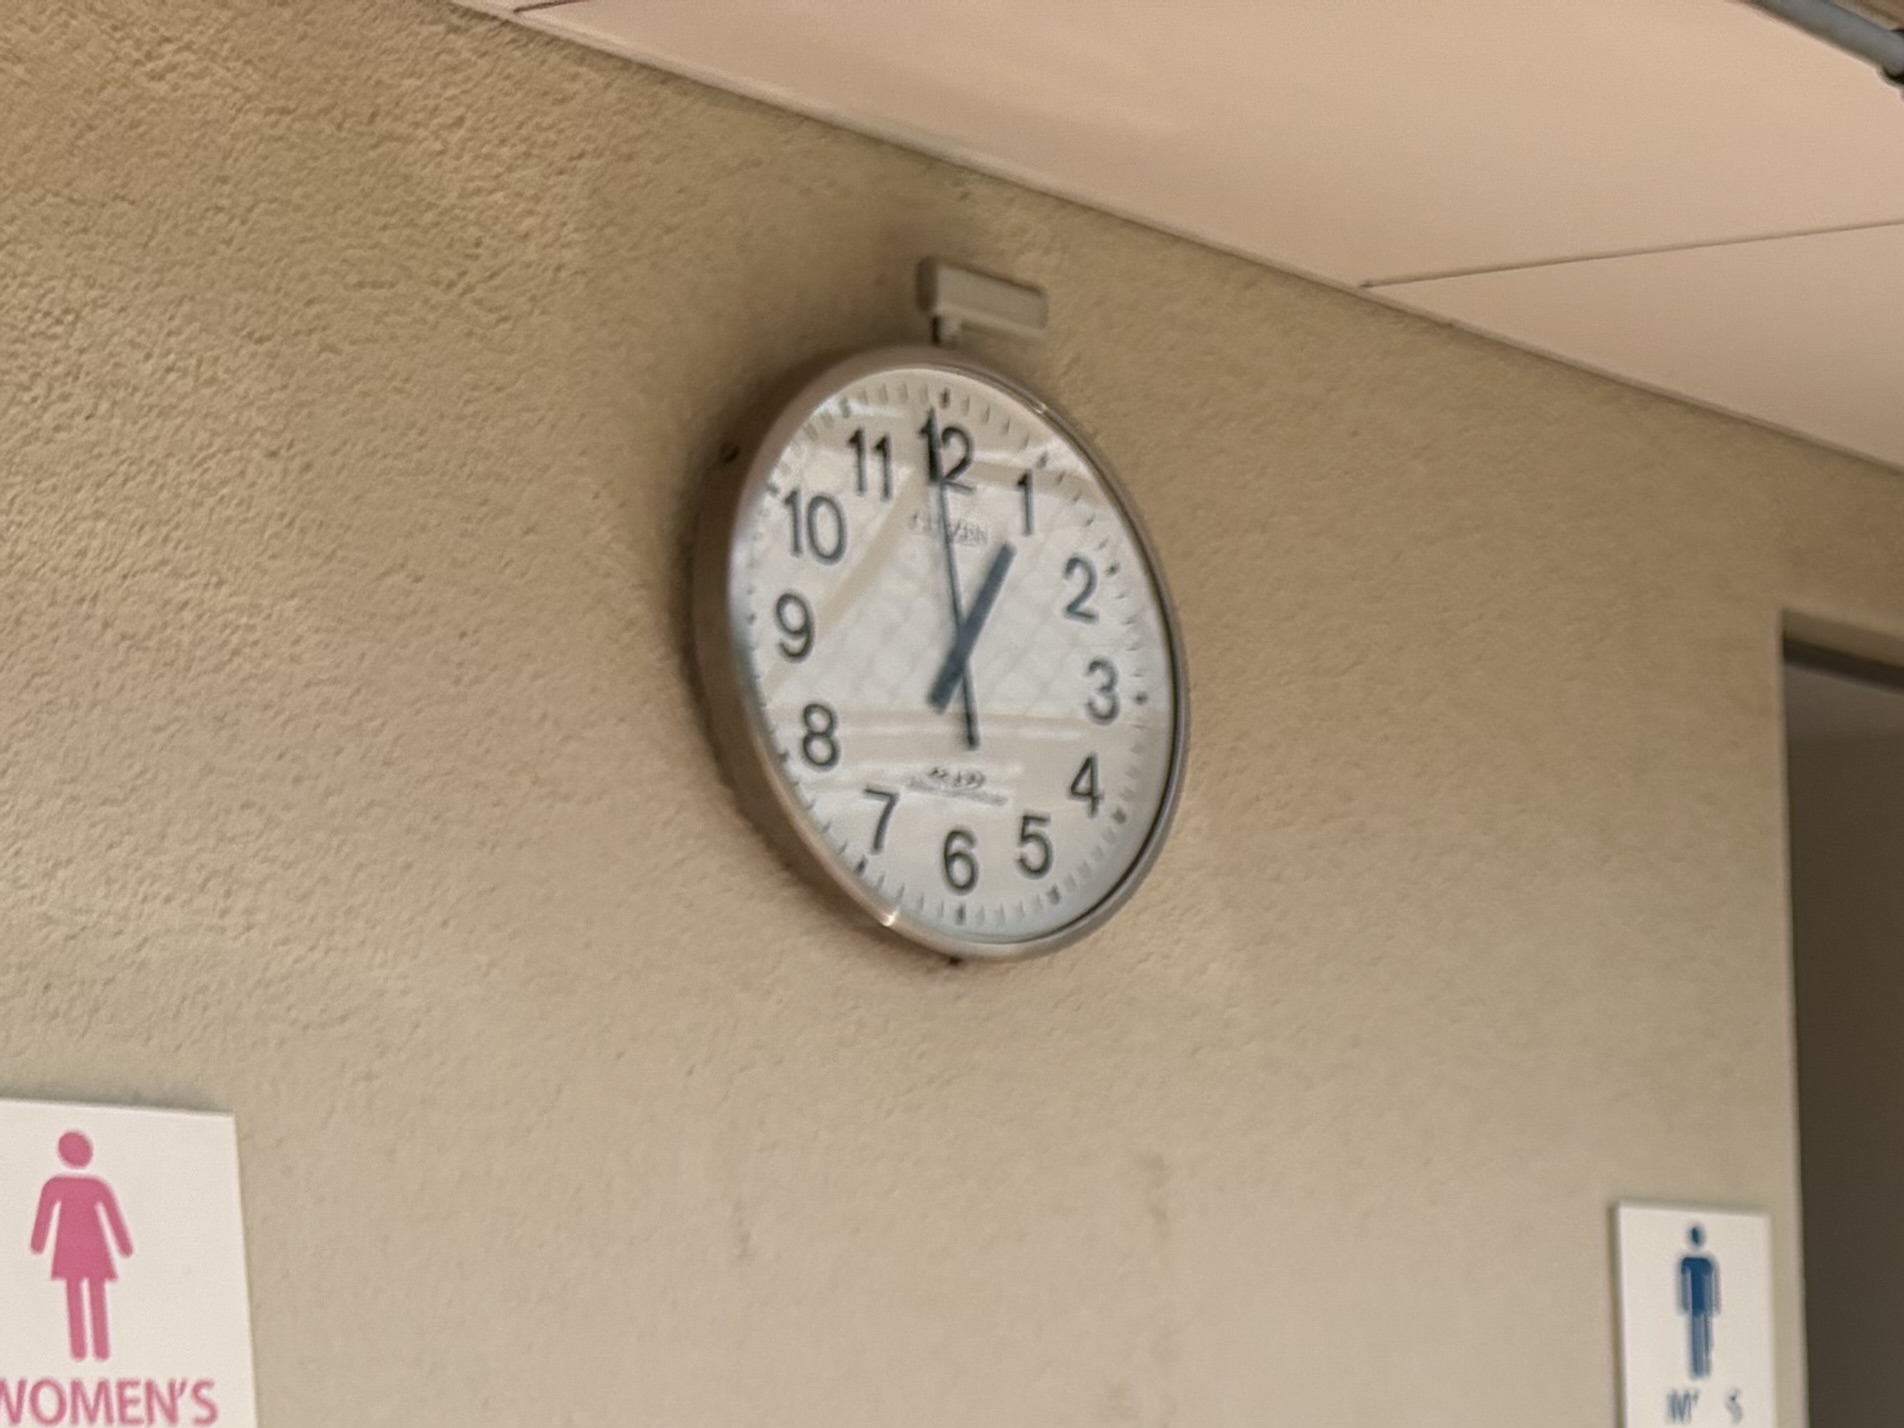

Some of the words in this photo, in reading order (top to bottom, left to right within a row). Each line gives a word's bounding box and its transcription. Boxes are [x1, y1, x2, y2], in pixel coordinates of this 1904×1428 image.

[847, 427, 892, 502] 11
[918, 417, 976, 495] 12
[782, 487, 847, 565] 10
[1015, 467, 1035, 536] 1
[1062, 555, 1100, 624] 2
[774, 590, 815, 663] 9
[1083, 656, 1120, 726] 3
[800, 701, 842, 771] 8
[863, 783, 900, 854] 7
[1066, 751, 1104, 818] 4
[943, 826, 980, 896] 6
[1014, 812, 1054, 880] 5
